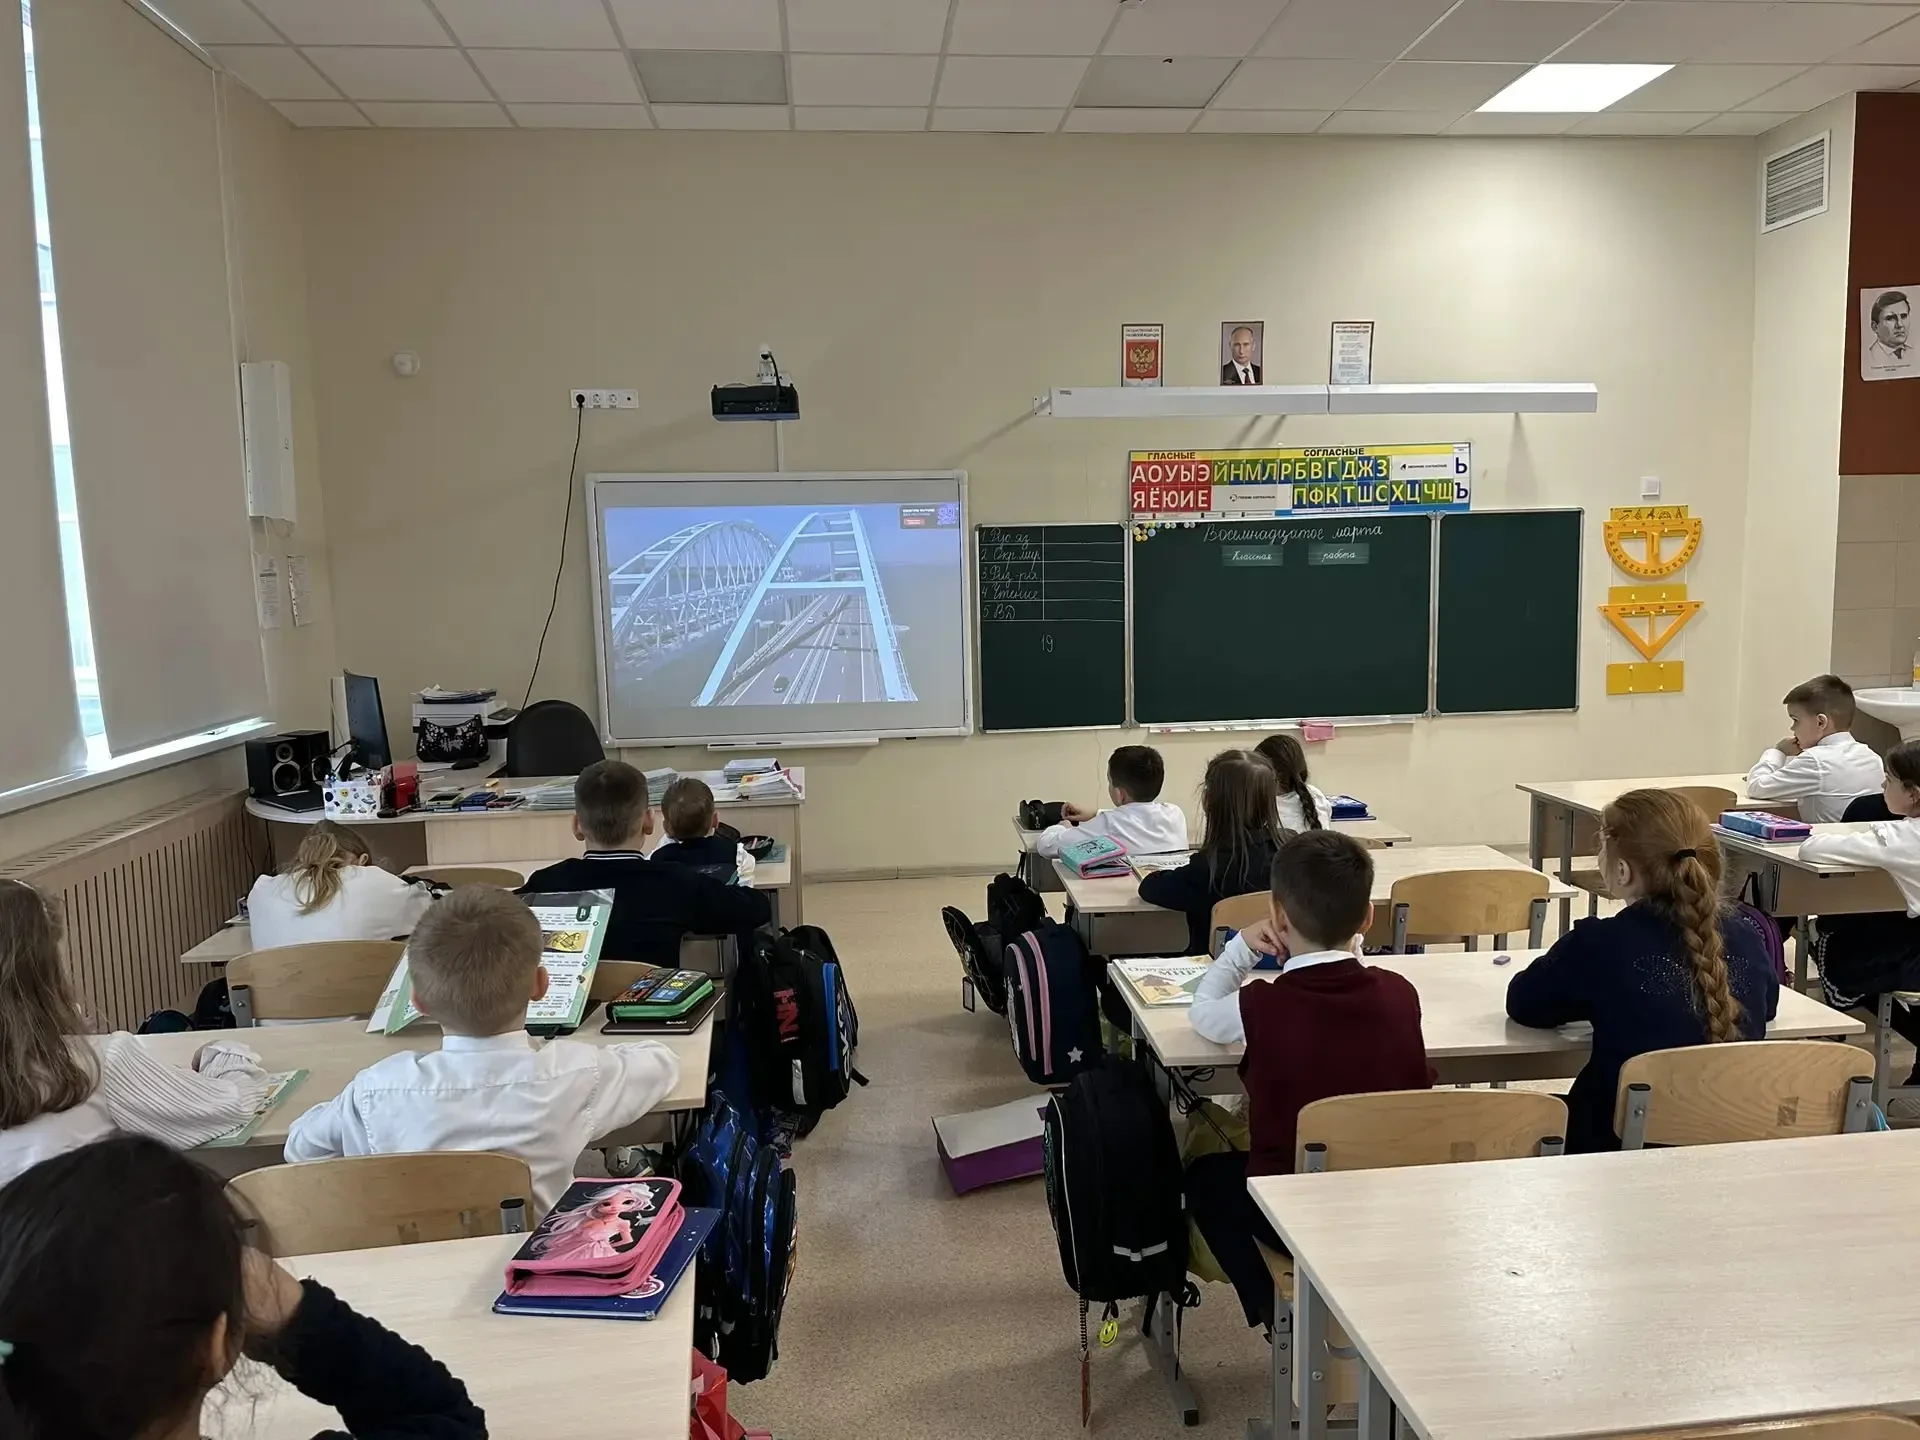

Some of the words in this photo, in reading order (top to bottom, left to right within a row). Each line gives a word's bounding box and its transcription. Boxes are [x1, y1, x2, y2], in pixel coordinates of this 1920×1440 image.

[1147, 451, 1196, 461] ГЛАСНЫЕ
[1303, 447, 1365, 457] СОГЛАСНЫЕ
[1204, 523, 1324, 545] Восемнадцатое
[1332, 524, 1383, 543] марта
[1320, 548, 1357, 563] работа
[1041, 634, 1054, 653] 19
